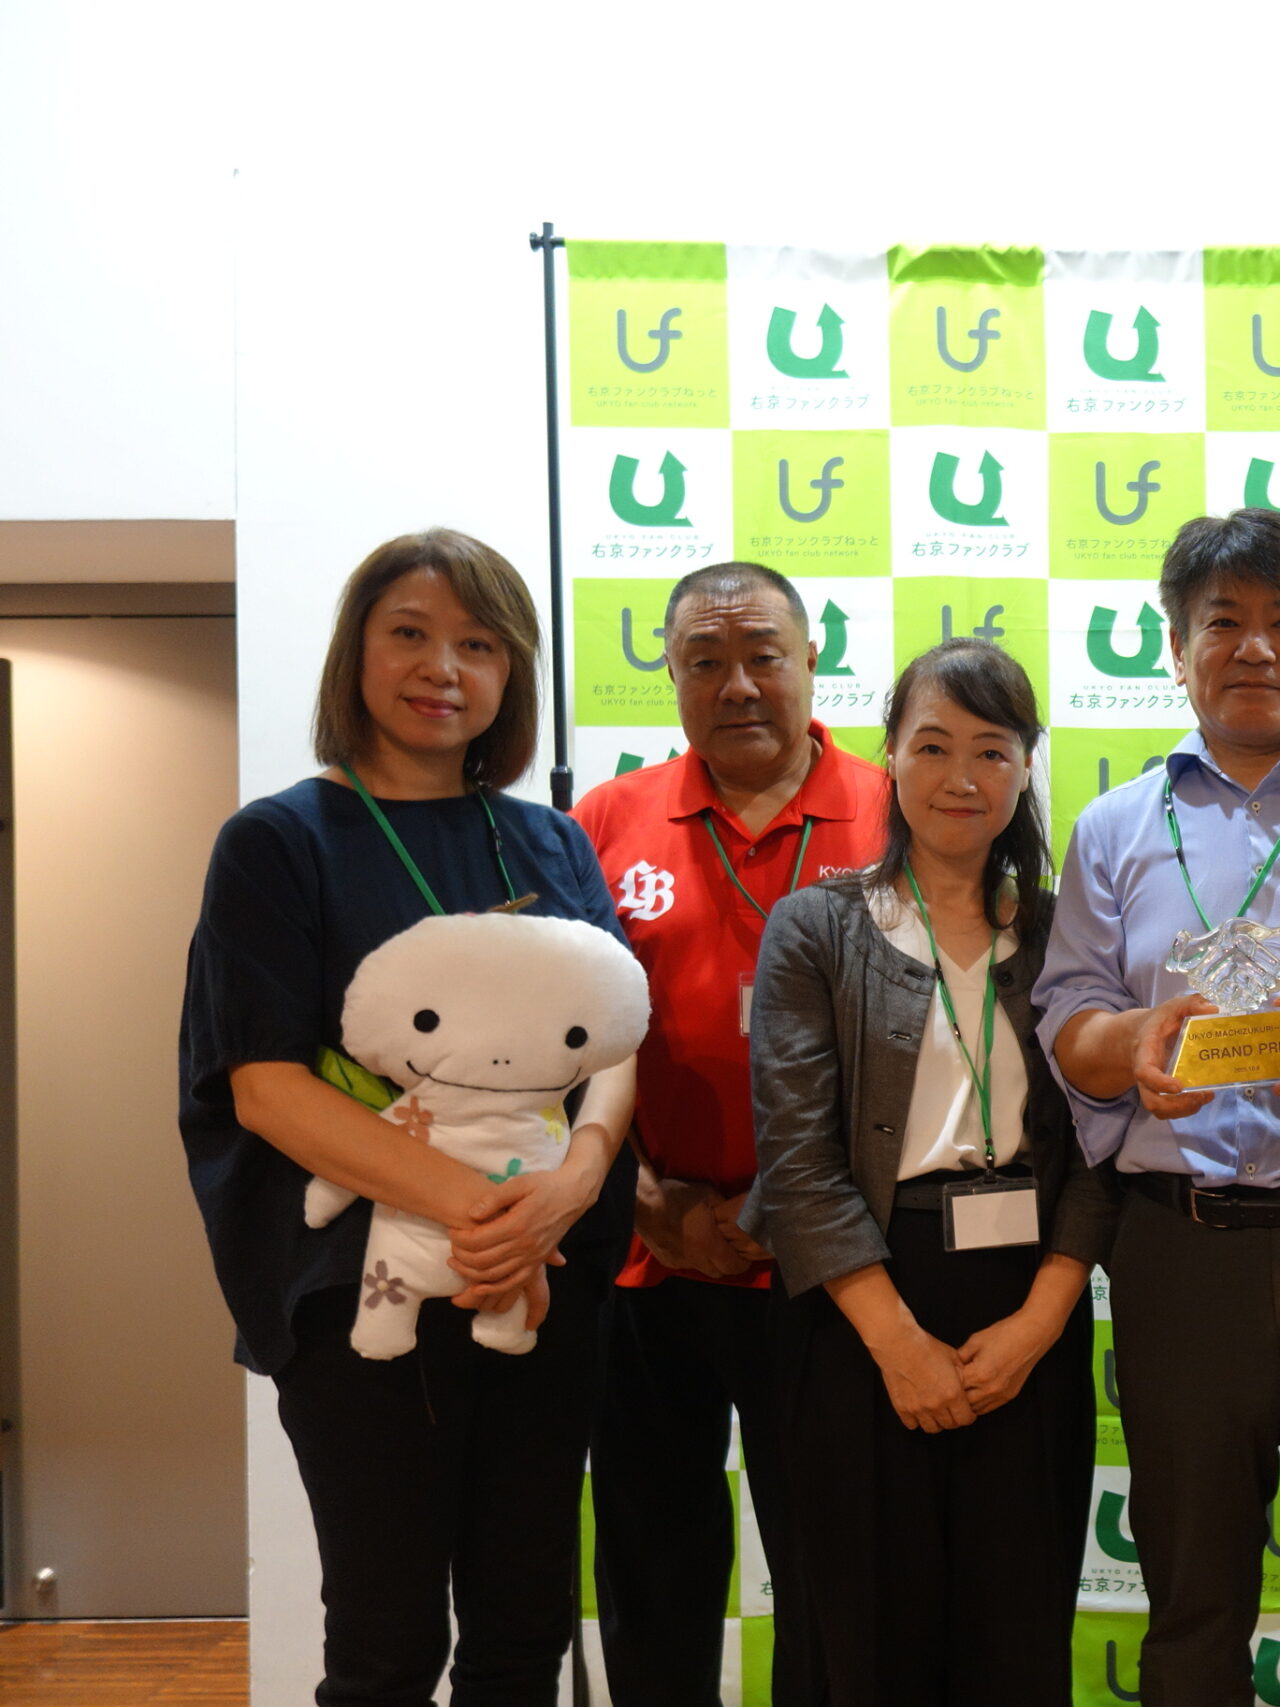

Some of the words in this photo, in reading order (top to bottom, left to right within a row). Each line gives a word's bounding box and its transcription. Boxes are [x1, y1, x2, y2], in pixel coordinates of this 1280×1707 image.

[752, 394, 870, 411] 右京ファンクラブ
[1067, 397, 1186, 412] 右京ファンクラブ
[750, 535, 880, 548] 右京ファンクラブねっと
[1067, 538, 1171, 551] 右京ファンクラブね
[592, 542, 714, 558] 右京ファンクラブ
[758, 548, 782, 558] UKYO
[785, 548, 800, 558] fan
[802, 548, 821, 558] club
[912, 541, 1030, 557] 右京ファンクラブ
[1074, 551, 1099, 560] UKYO
[1102, 551, 1116, 560] fan
[1119, 551, 1137, 560] club
[601, 698, 626, 706] UKYO
[629, 698, 643, 706] fan
[646, 698, 664, 706] club
[1188, 1031, 1213, 1041] UKYO
[1199, 1044, 1254, 1061] GRAND
